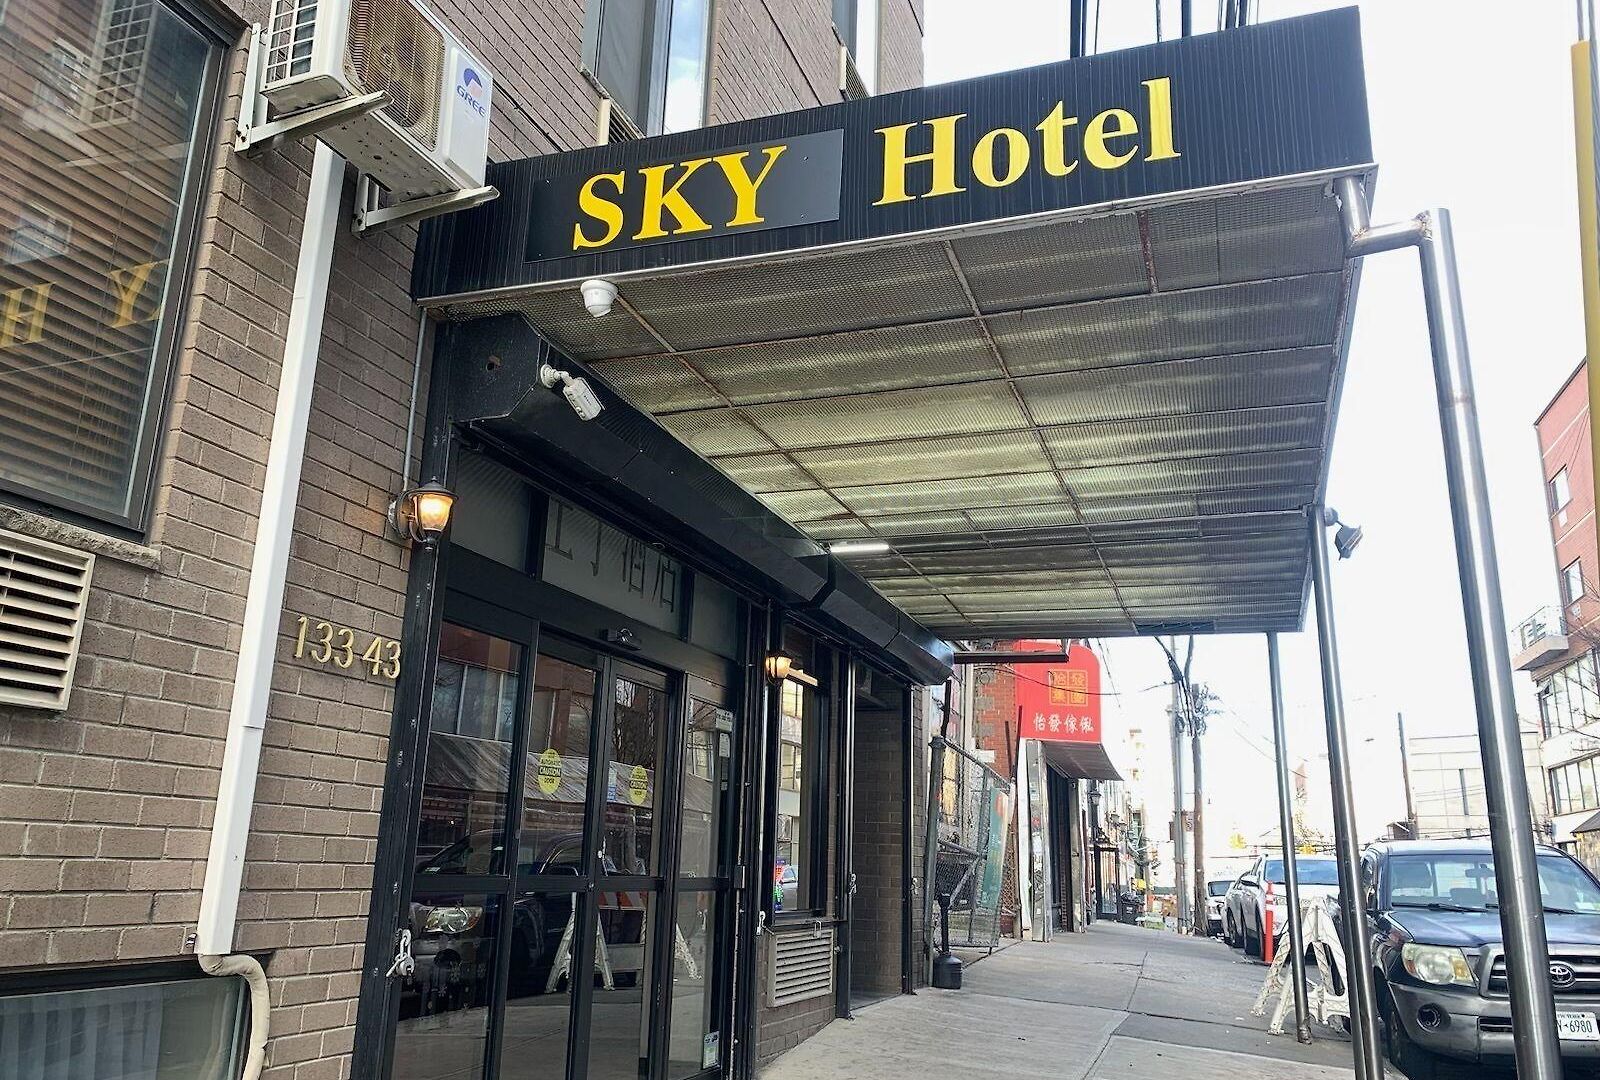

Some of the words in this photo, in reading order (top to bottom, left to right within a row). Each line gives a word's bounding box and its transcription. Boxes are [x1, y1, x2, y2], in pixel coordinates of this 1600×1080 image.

[456, 85, 487, 117] GREE
[572, 145, 788, 251] SKY
[872, 76, 1182, 207] Hotel
[539, 767, 561, 777] CAUTION
